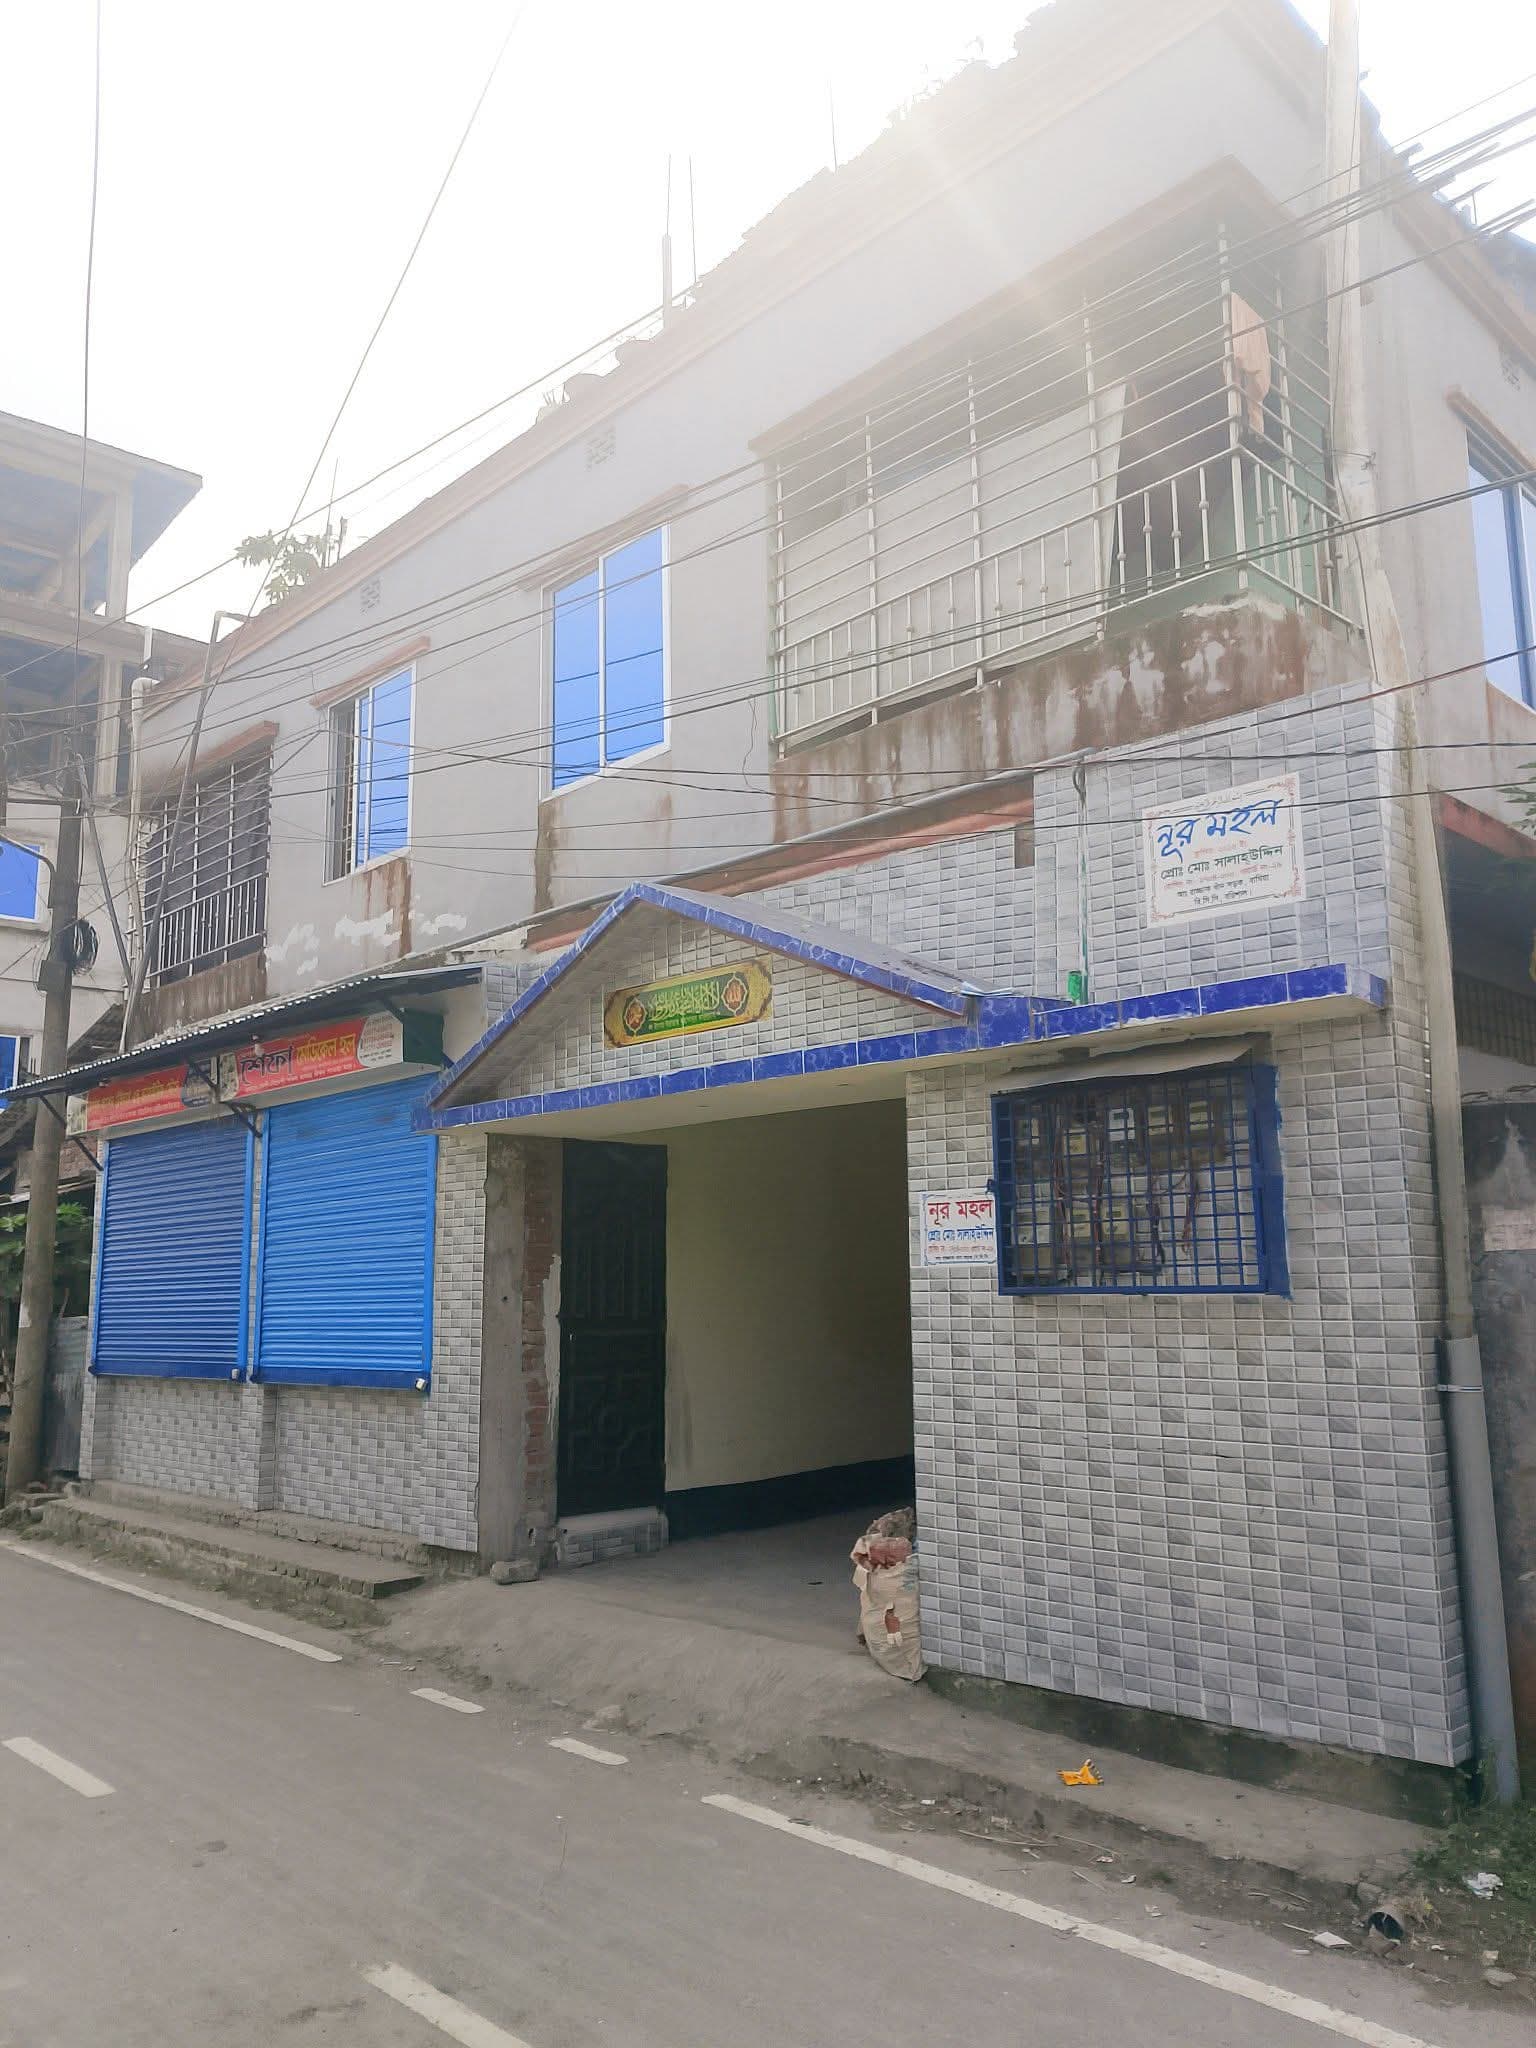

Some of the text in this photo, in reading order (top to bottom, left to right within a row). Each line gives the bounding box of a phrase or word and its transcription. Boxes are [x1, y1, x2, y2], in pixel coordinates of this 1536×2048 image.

[1157, 799, 1285, 864] নূর মহল
[1187, 861, 1210, 875] মোঃ
[239, 1045, 292, 1085] শেফা
[339, 1033, 356, 1057] হল
[927, 1199, 994, 1228] নূর মহল
